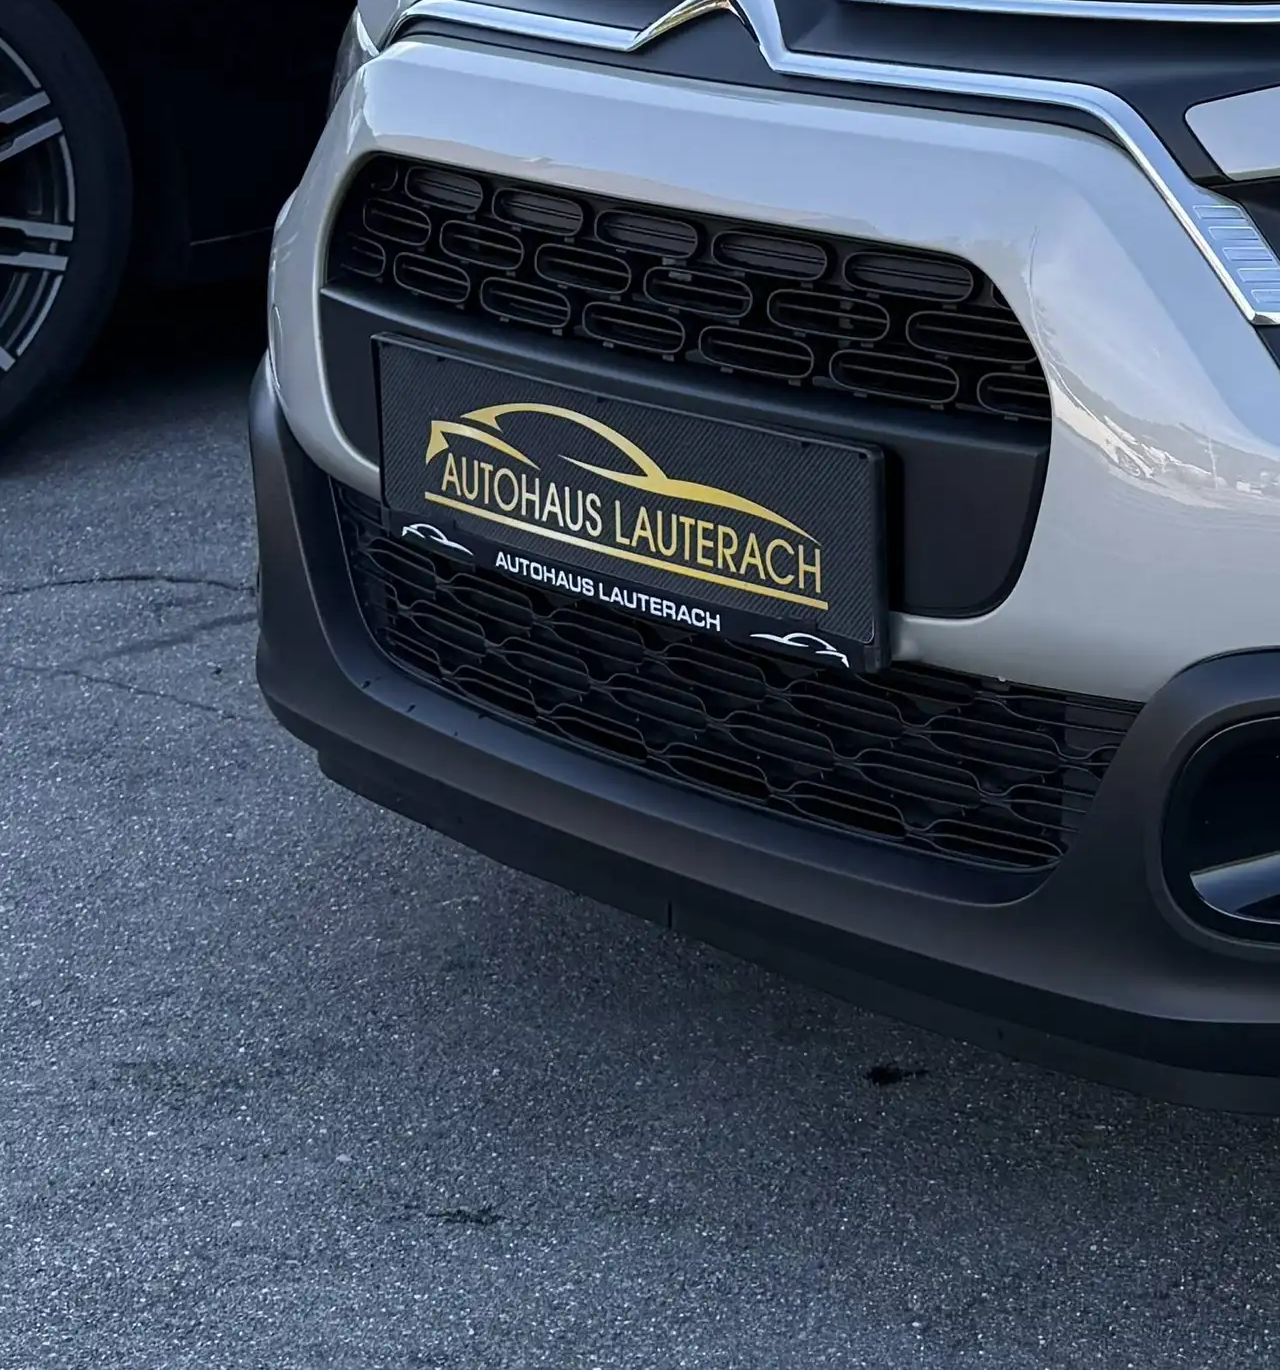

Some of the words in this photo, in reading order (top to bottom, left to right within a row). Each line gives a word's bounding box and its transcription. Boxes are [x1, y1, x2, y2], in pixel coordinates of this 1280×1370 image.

[440, 451, 603, 539] AUTOHAUS
[614, 499, 823, 595] LAUTERACH
[494, 551, 595, 598] AUTOHAUS
[598, 580, 722, 632] LAUTERACH
